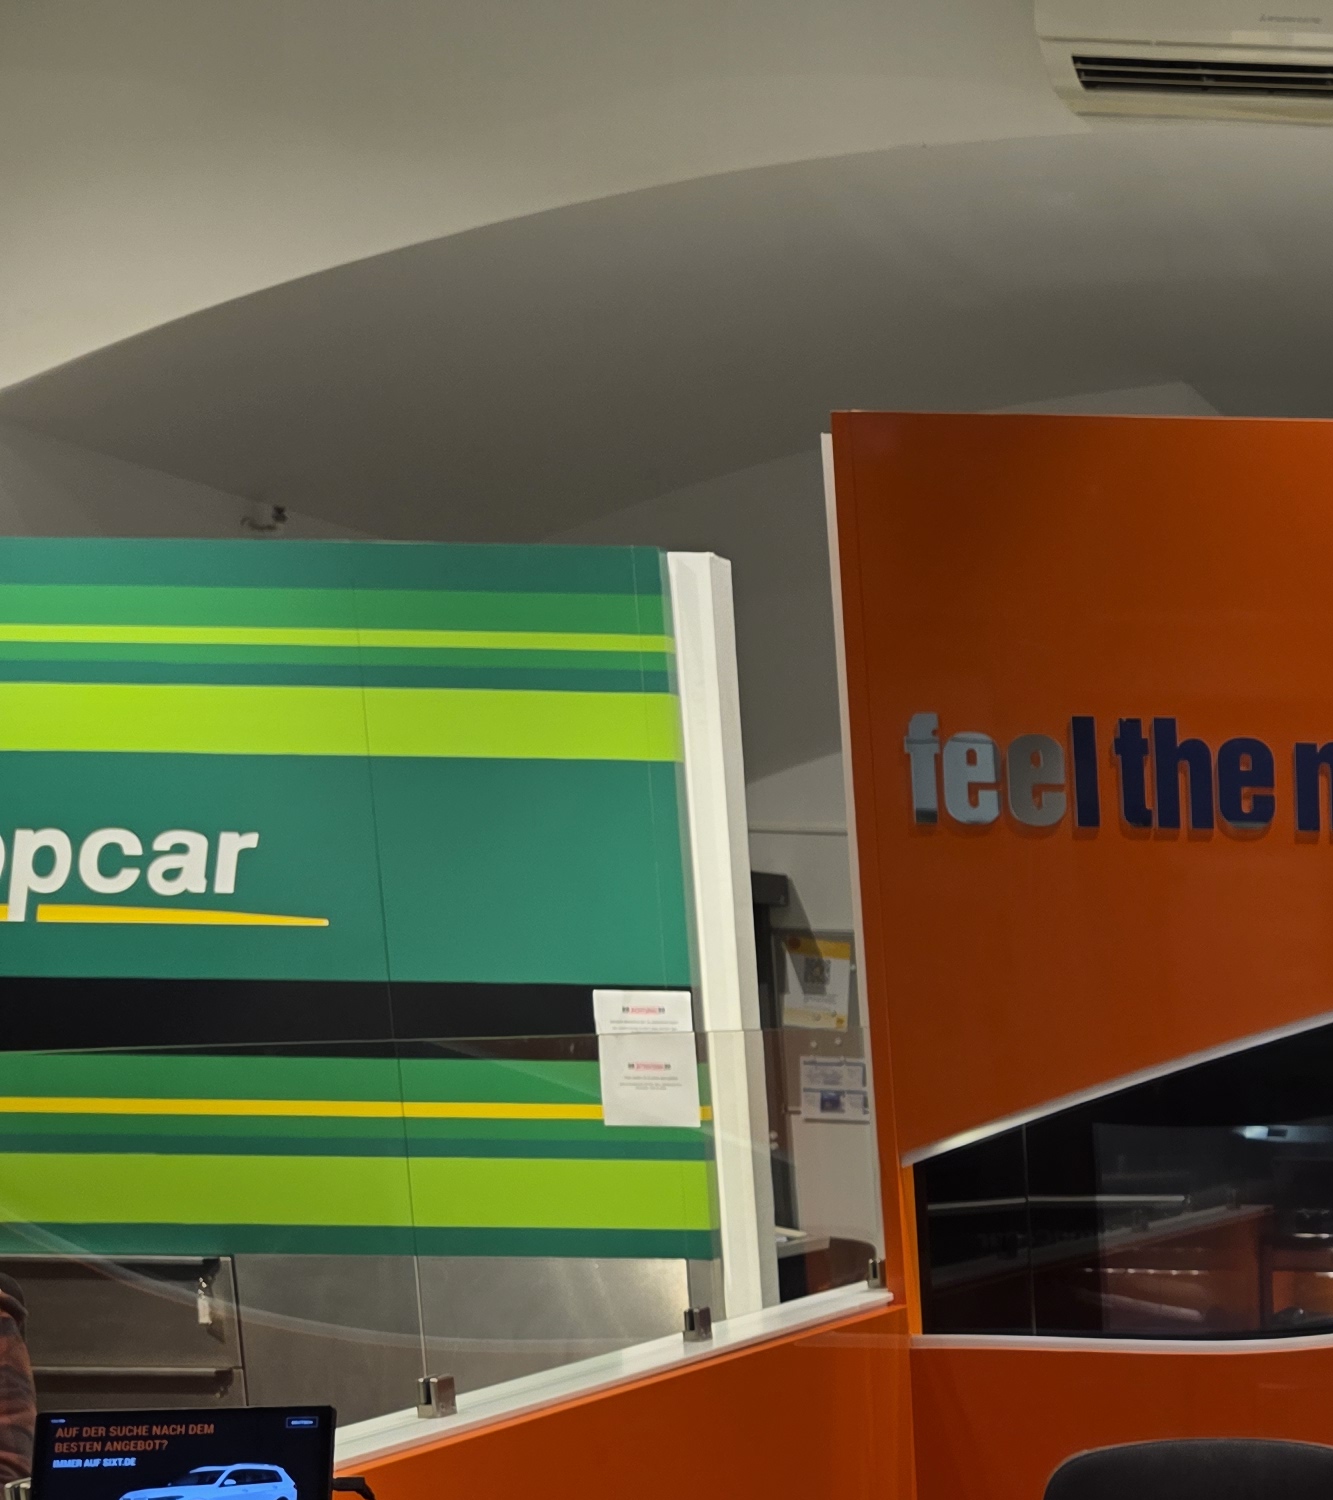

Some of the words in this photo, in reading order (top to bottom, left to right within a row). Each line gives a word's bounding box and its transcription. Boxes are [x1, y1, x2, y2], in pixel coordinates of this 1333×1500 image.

[904, 711, 1100, 827] feel
[1114, 717, 1276, 830] the
[0, 827, 259, 922] pcar
[55, 1427, 80, 1438] AUF
[82, 1426, 106, 1437] DER
[109, 1425, 150, 1437] SUCHE
[152, 1424, 186, 1436] NACH
[188, 1423, 215, 1435] DEM
[54, 1441, 102, 1453] BESTEN
[104, 1440, 169, 1452] ANGEBOT?
[83, 1458, 101, 1468] AUF
[102, 1457, 137, 1468] SIXT.DE
